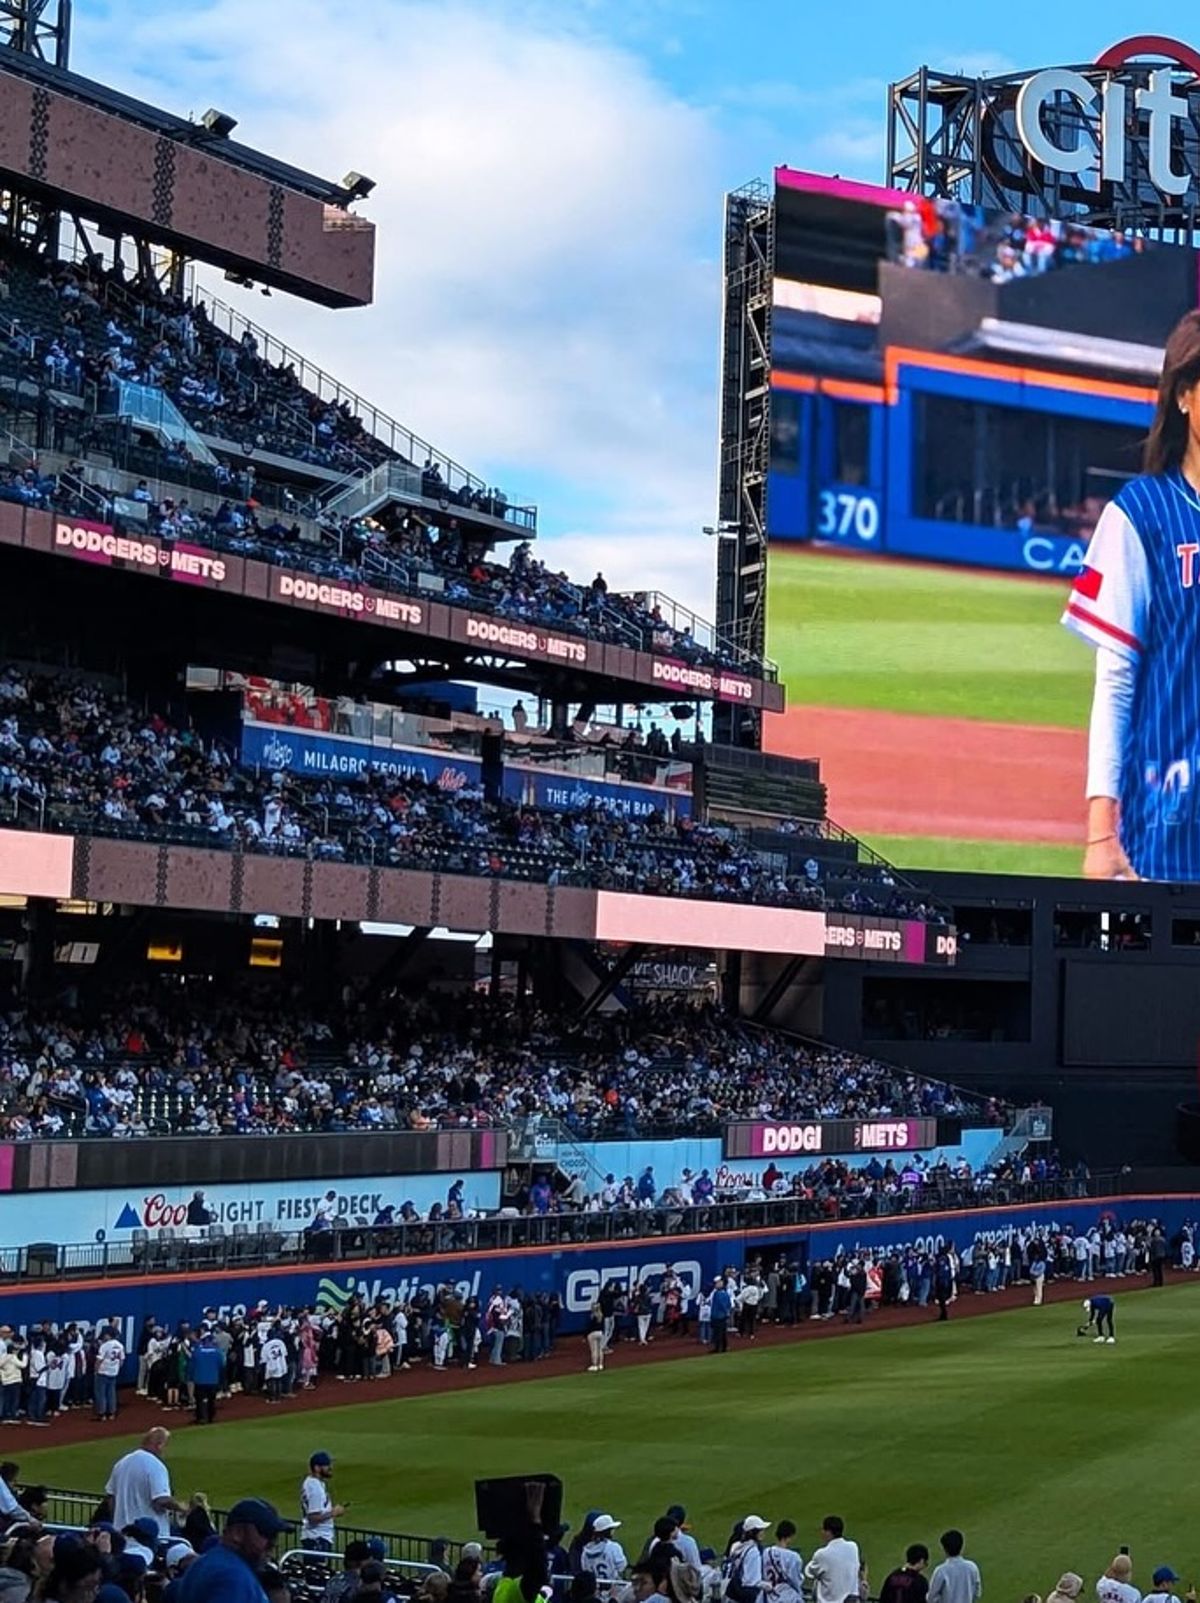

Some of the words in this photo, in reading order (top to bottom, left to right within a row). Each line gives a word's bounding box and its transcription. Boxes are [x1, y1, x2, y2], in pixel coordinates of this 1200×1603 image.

[819, 491, 879, 540] 370
[56, 523, 156, 565] DODGERS
[171, 550, 226, 581] METS
[280, 576, 364, 611] DODGERS
[376, 597, 422, 625] METS
[467, 618, 537, 651] DODGERS
[547, 637, 586, 661] METS
[653, 662, 712, 690] DODGERS
[720, 677, 752, 699] METS
[547, 787, 568, 805] THE
[826, 925, 855, 947] ERS
[864, 929, 901, 951] METS
[653, 963, 698, 986] SHACK
[861, 1122, 908, 1148] METS
[143, 1193, 187, 1227] Coo
[213, 1201, 265, 1223] IGHT
[338, 1193, 383, 1215] DECK
